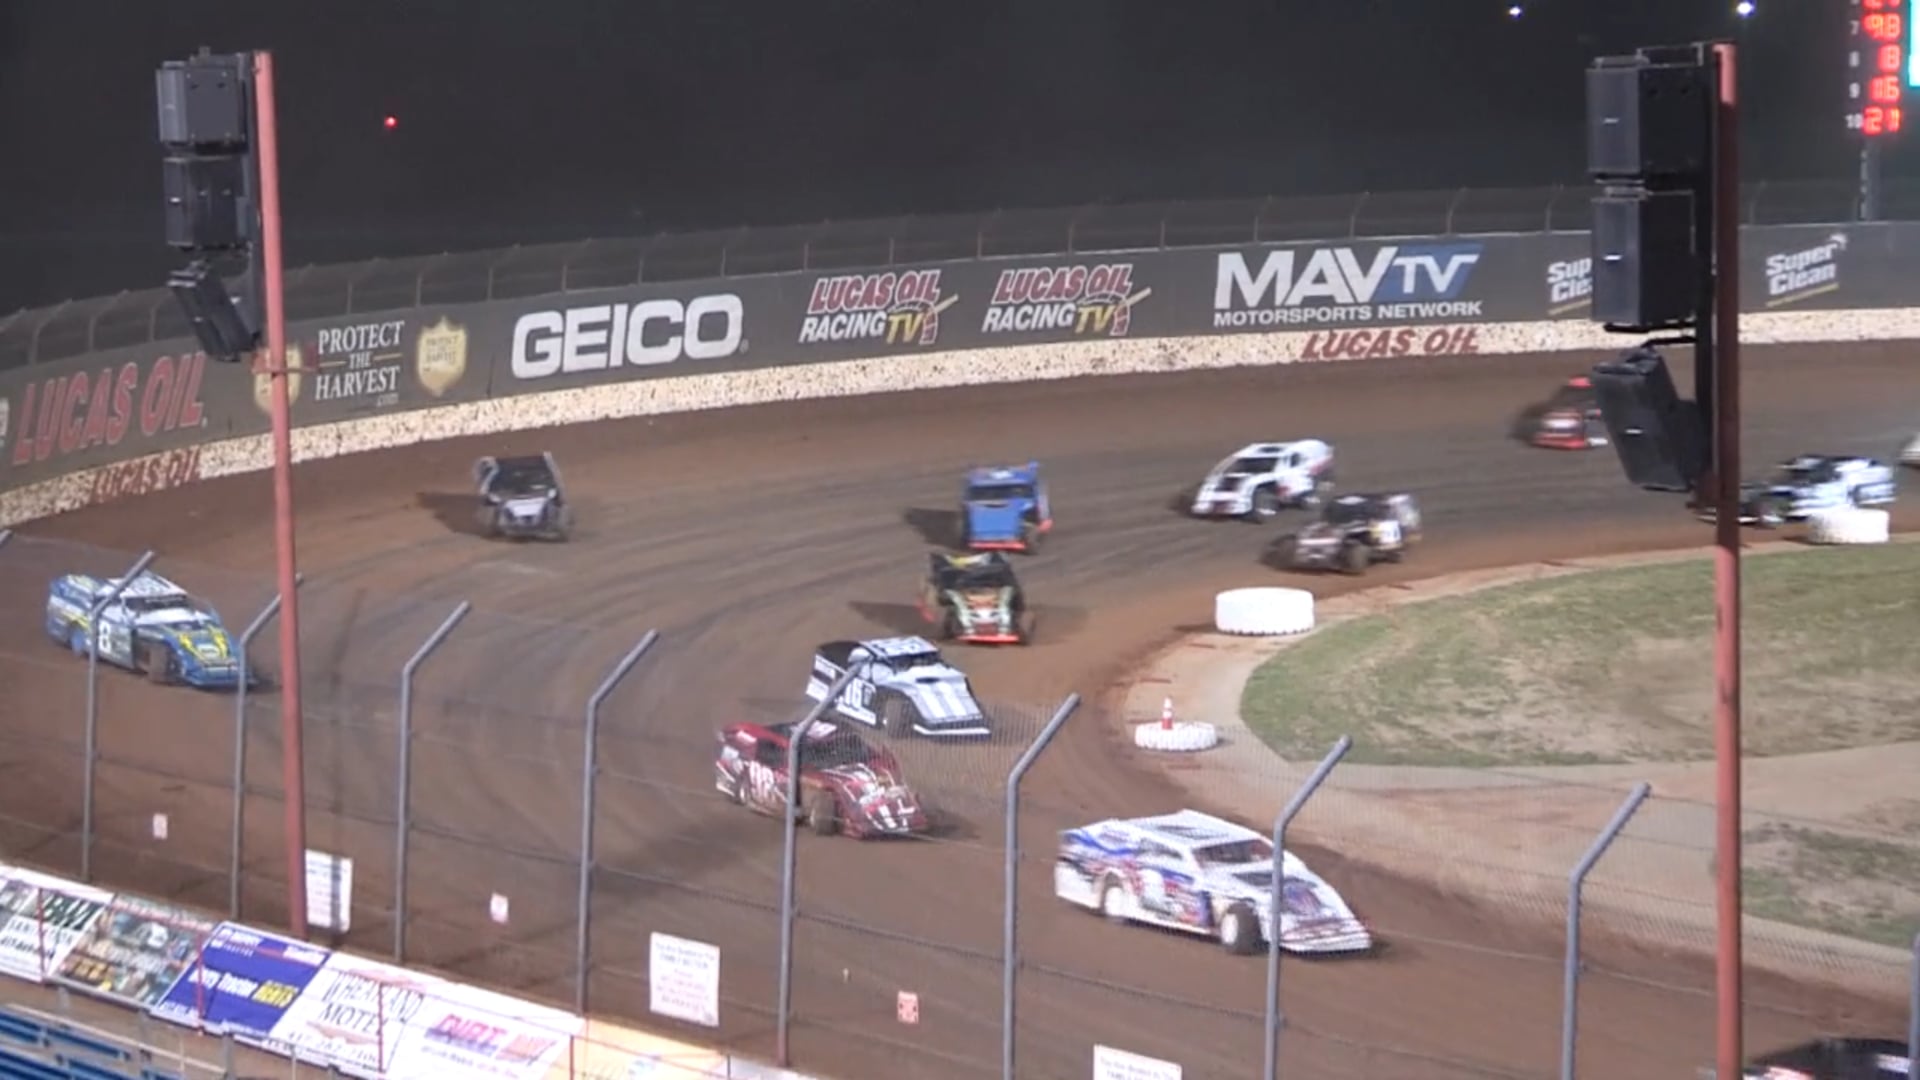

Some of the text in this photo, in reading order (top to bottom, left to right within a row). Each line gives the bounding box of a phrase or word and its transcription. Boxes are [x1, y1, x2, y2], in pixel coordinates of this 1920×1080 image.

[1548, 258, 1592, 283] Sup
[1766, 243, 1837, 276] Super
[808, 269, 941, 314] LUCAS OIL
[991, 264, 1133, 305] LUCAS OIL
[1551, 278, 1592, 302] Cle
[1769, 263, 1836, 295] Clean
[799, 311, 887, 343] RACING
[982, 303, 1077, 333] RACING
[1214, 300, 1482, 327] MOTORSPORTS NETWORK
[318, 321, 404, 354] PROTECT
[511, 294, 743, 378] GEICO
[1301, 325, 1479, 359] LUCAS OIL
[349, 352, 371, 370] THE
[315, 367, 399, 400] HARVEST
[13, 362, 138, 465] LUCAS
[140, 351, 206, 437] OIL
